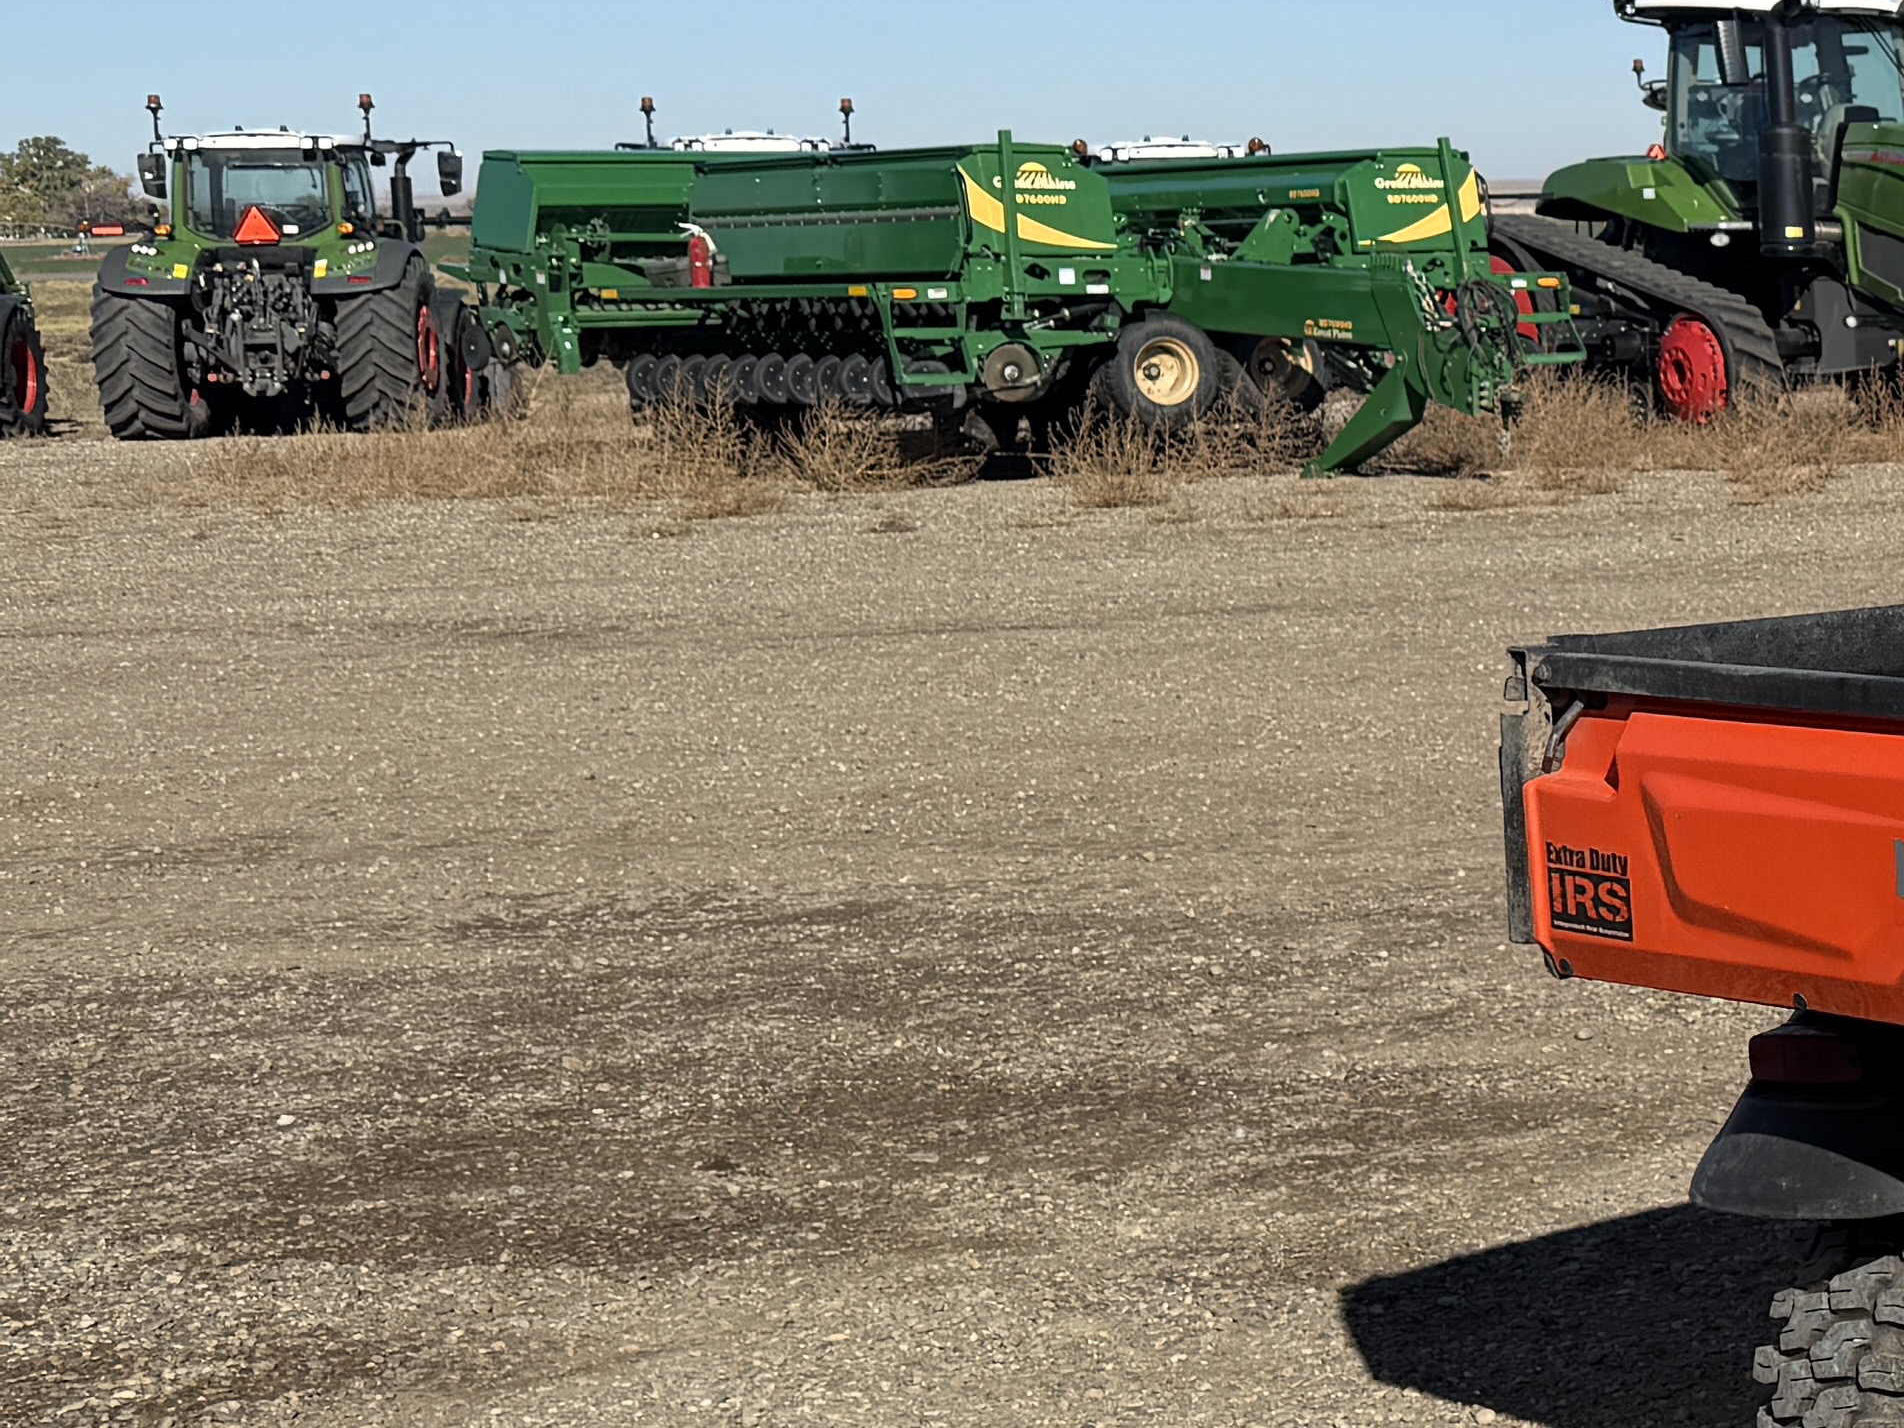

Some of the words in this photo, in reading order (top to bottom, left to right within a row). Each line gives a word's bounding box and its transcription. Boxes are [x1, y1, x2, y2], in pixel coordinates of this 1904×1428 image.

[1545, 840, 1586, 869] Extra
[1589, 847, 1629, 877] Duty
[1551, 872, 1630, 922] IRS
